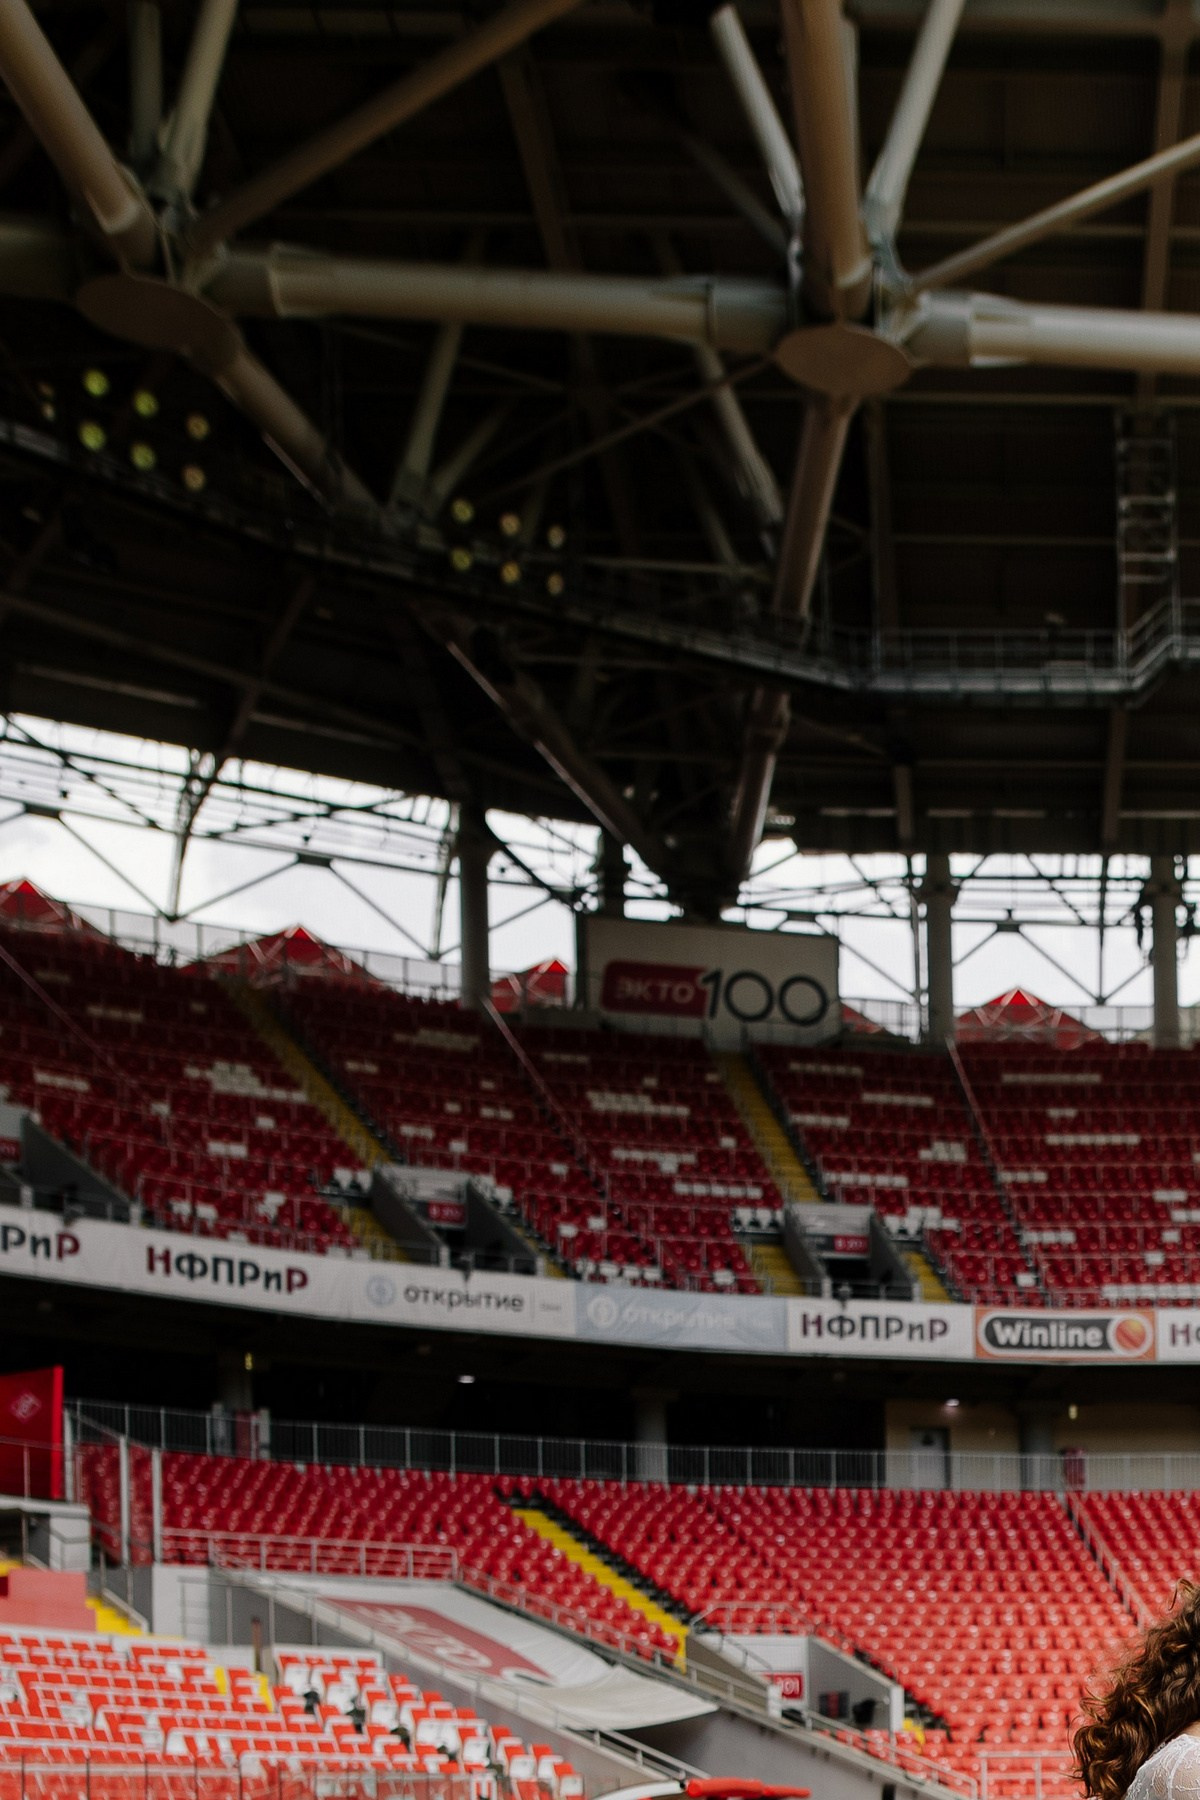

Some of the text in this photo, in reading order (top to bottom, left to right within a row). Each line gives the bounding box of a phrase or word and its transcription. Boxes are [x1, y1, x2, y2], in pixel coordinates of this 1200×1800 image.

[701, 968, 828, 1026] 100
[146, 1245, 309, 1294] НФПРиР
[403, 1284, 525, 1312] открытие
[802, 1312, 949, 1342] НФПРиР
[992, 1319, 1104, 1348] Winline
